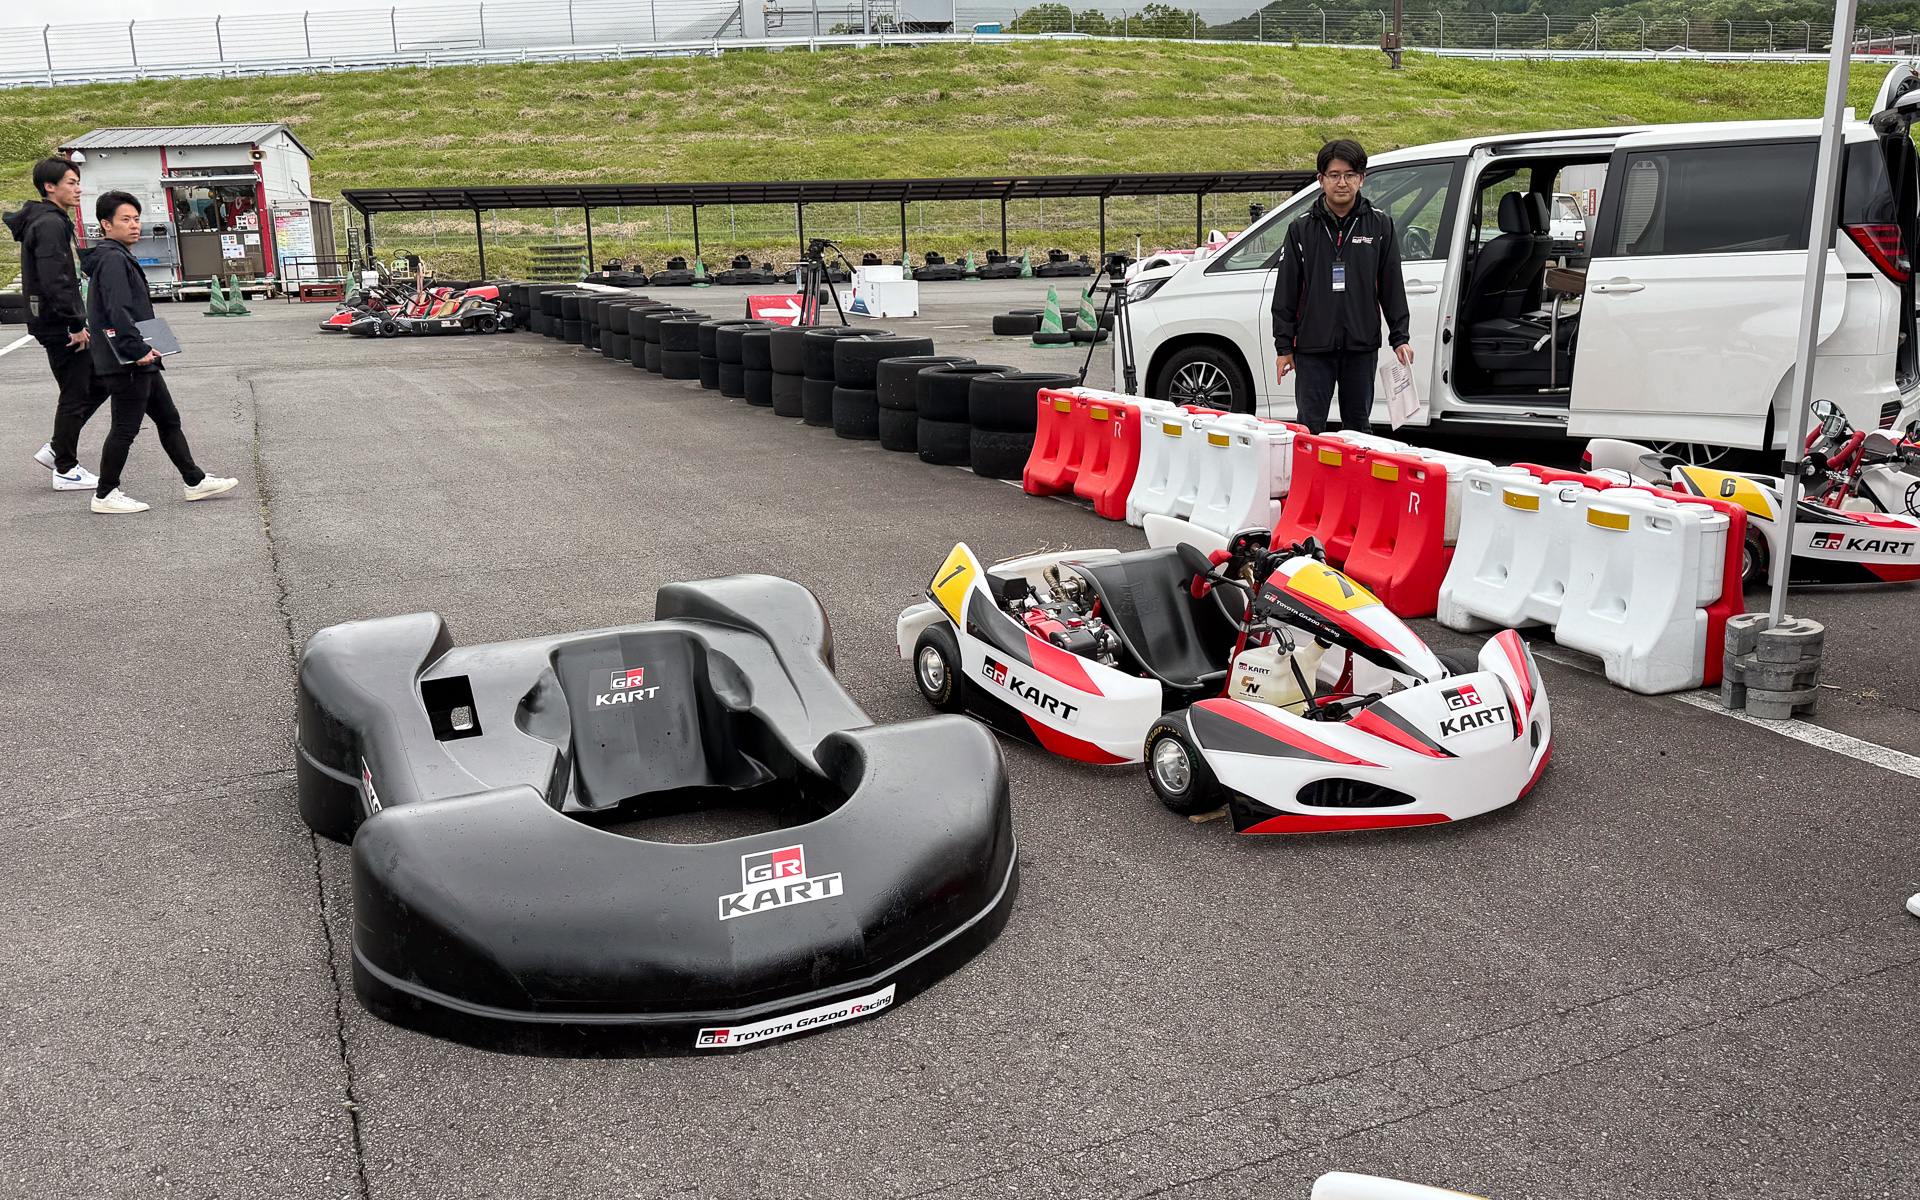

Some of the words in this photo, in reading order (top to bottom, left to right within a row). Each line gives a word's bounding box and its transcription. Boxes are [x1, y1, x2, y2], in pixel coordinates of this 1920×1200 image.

[1114, 421, 1122, 439] R
[1720, 478, 1737, 497] 6
[1408, 491, 1421, 515] R
[1811, 537, 1841, 549] GR
[1846, 538, 1915, 554] KART
[1264, 593, 1277, 603] GR
[1276, 600, 1299, 615] TOYOTA
[1299, 612, 1320, 626] GAZOO
[1320, 624, 1340, 638] Racing
[1248, 665, 1270, 675] KART
[613, 675, 642, 688] GR
[983, 663, 1005, 685] GR
[1010, 676, 1078, 719] KART
[1241, 676, 1261, 694] CN
[595, 686, 660, 706] KART
[1447, 691, 1481, 709] GR
[1440, 706, 1505, 737] KART
[747, 858, 801, 883] GR
[722, 875, 839, 917] KART
[700, 1034, 728, 1044] GR
[734, 1023, 793, 1042] TOYOTA
[796, 1009, 848, 1028] GAZOO
[850, 994, 892, 1014] Racing
